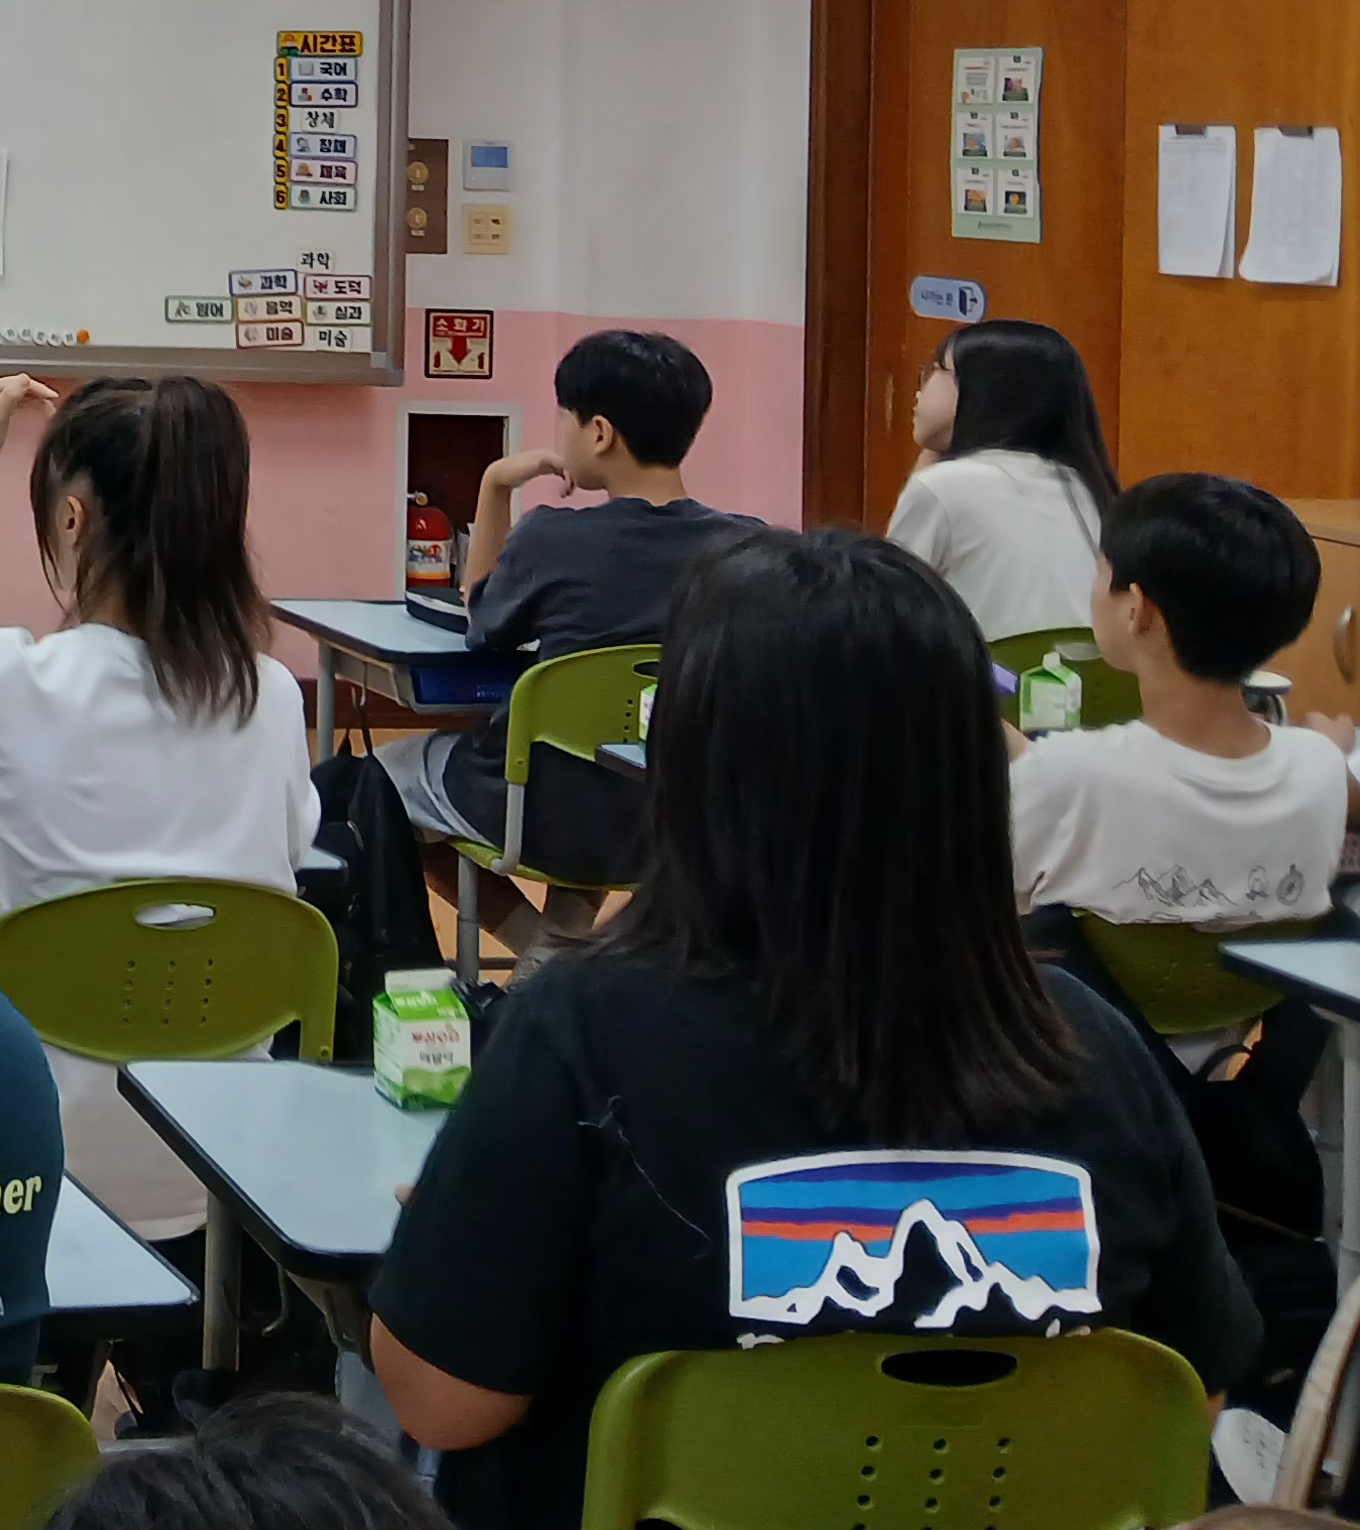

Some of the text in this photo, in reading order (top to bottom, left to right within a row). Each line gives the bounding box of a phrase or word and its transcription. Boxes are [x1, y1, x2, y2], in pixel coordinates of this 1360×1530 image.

[300, 34, 357, 54] 시간표
[277, 62, 347, 77] 1 국어
[276, 87, 347, 102] 2 수학
[275, 113, 286, 127] 3
[275, 138, 287, 152] 4
[276, 164, 347, 180] 5 체육
[276, 190, 347, 206] 6 사회
[300, 251, 331, 270] 과학
[259, 274, 288, 291] 과학
[333, 279, 363, 295] 도덕
[265, 300, 294, 316] 음악
[335, 305, 363, 320] 실과
[436, 318, 485, 332] 소화기
[266, 326, 294, 342] 미술
[319, 328, 348, 349] 미술
